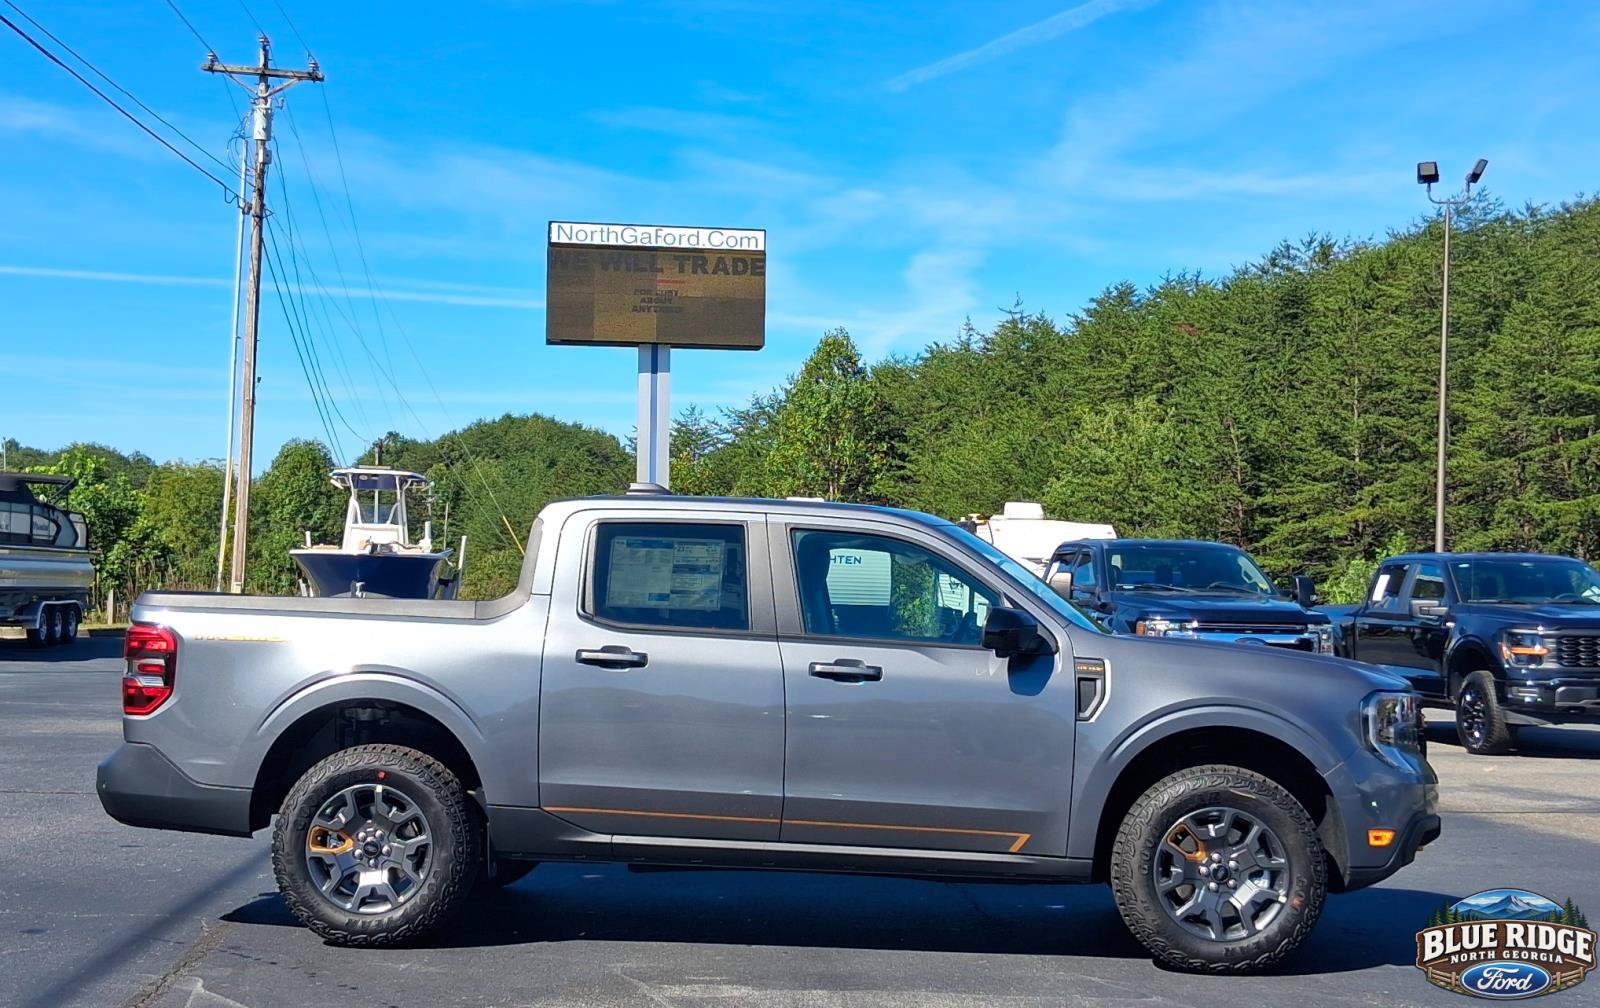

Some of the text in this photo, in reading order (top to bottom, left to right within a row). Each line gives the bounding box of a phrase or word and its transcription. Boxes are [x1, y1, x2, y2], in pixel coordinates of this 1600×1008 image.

[556, 224, 759, 249] NorthGaFord.Com
[601, 253, 665, 274] WILL
[673, 255, 765, 277] TRADE
